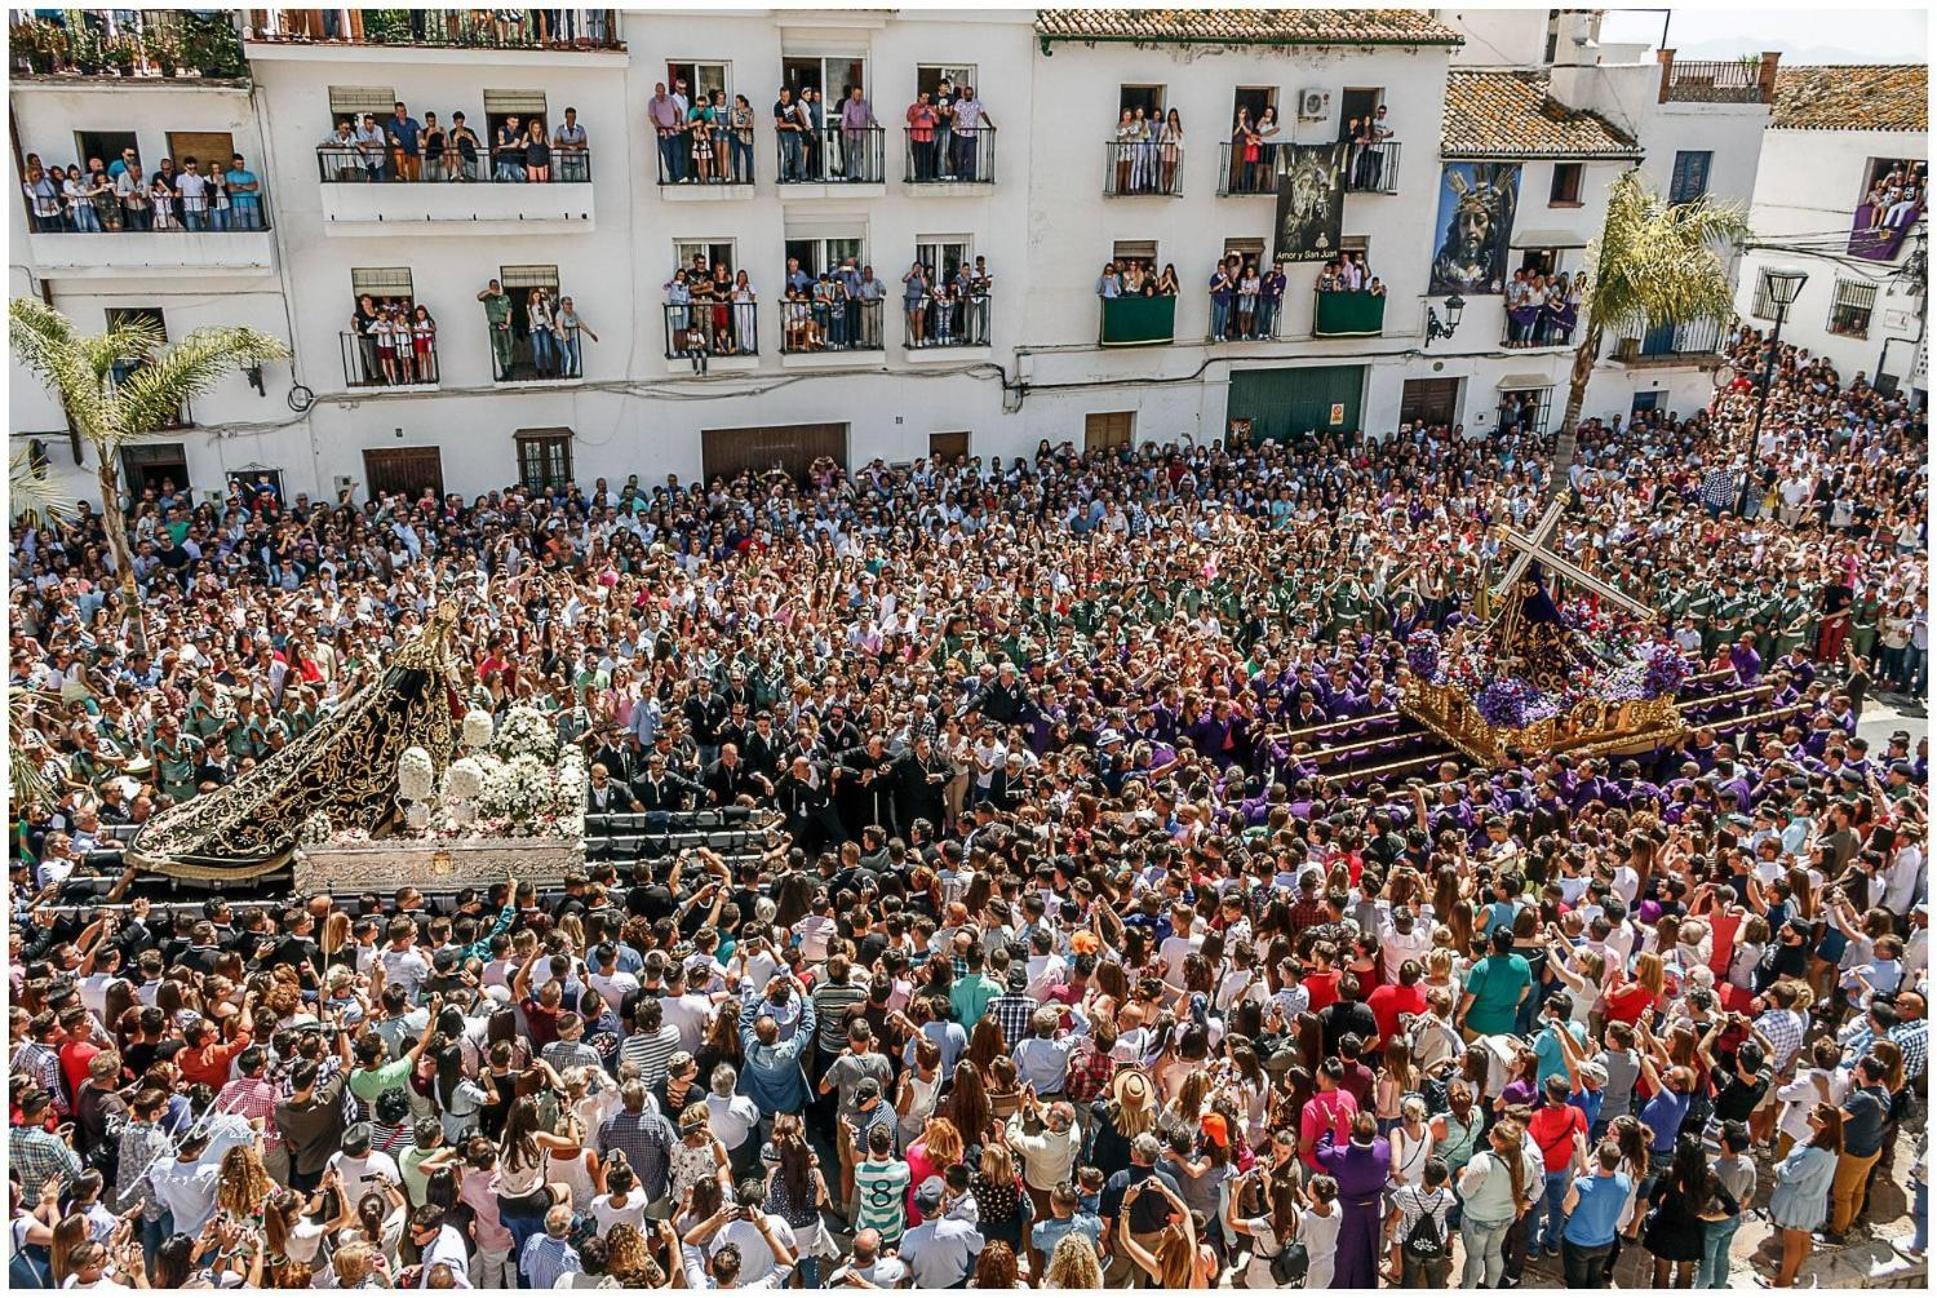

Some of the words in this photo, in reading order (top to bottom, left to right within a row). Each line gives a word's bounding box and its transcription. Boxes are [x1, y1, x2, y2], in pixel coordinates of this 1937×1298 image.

[1276, 251, 1296, 259] Amor
[1297, 252, 1303, 260] y
[1304, 250, 1319, 259] San
[1320, 250, 1338, 258] Juan
[870, 1179, 892, 1207] 8
